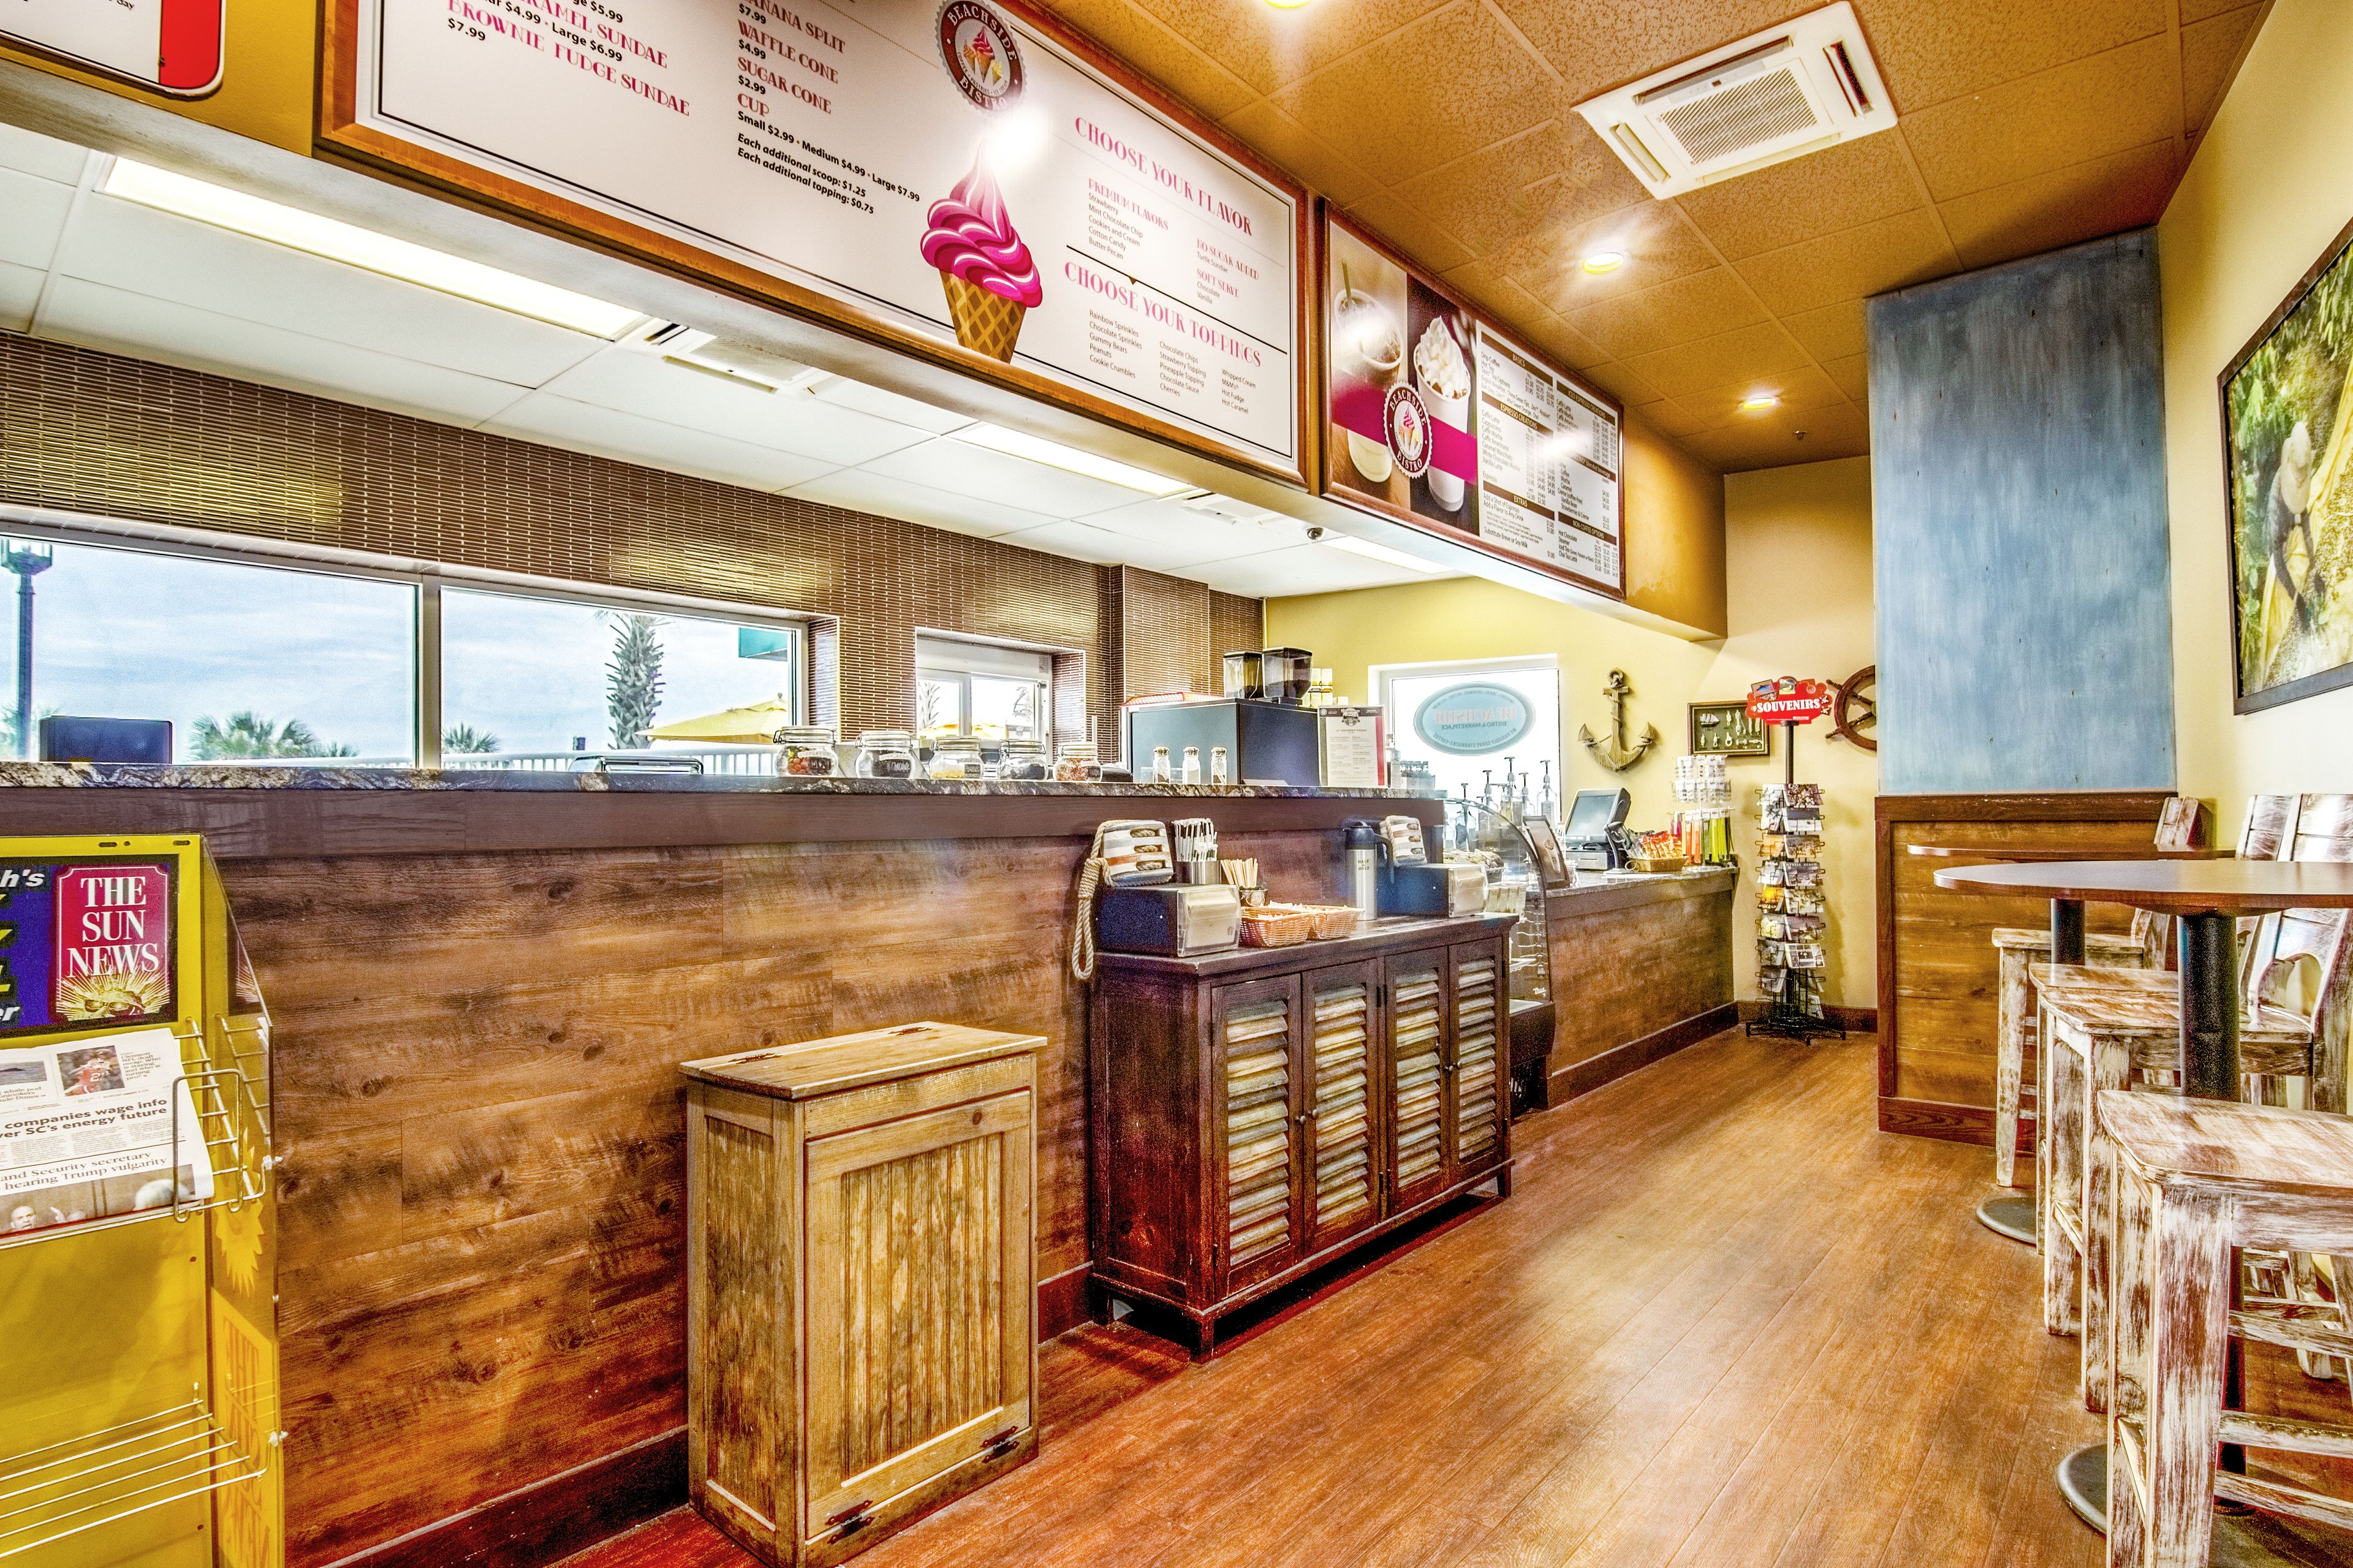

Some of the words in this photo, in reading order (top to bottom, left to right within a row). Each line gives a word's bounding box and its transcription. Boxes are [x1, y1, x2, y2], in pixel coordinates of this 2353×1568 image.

[591, 1, 623, 23] $5.99
[739, 4, 766, 24] $7.99
[448, 18, 486, 41] $7.99
[506, 1, 541, 24] $4.99
[552, 22, 586, 47] Large
[591, 40, 623, 62] $6.99
[746, 0, 802, 31] ANANA
[806, 23, 846, 53] SPLIT
[948, 4, 1017, 60] BEACHSIDE
[597, 23, 667, 68] SUNDAE
[738, 19, 795, 62] WAFFLE
[799, 54, 838, 84] CONE
[739, 39, 766, 59] $4.99
[447, 0, 544, 51] BROWNIE
[554, 43, 616, 84] FUDGE
[621, 73, 689, 117] SUNDAE
[738, 75, 766, 94] $2.99
[738, 57, 789, 93] SUGAR
[792, 84, 831, 114] CONE
[960, 75, 1008, 110] BISTRO
[738, 93, 769, 116] CUP
[738, 111, 765, 131] Small
[768, 125, 794, 143] $2.99
[802, 140, 839, 165] Medium
[841, 159, 865, 176] $4.99
[873, 173, 896, 191] Large
[898, 186, 920, 202] $7.99
[738, 133, 760, 150] Each
[763, 146, 810, 173] additional
[813, 167, 840, 187] scoop:
[843, 181, 866, 197] $1.25
[738, 148, 760, 165] Each
[763, 161, 810, 186] additional
[813, 180, 849, 204] topping:
[851, 198, 874, 214] $0.75
[1075, 117, 1147, 174] CHOOSE
[1152, 161, 1194, 201] YOUR
[1199, 189, 1252, 236] FLAVOR
[1089, 178, 1130, 211] PREMIUM
[1132, 202, 1169, 230] FLAVORS
[1089, 193, 1118, 215] Strawberry
[1089, 204, 1101, 217] Mint
[1103, 209, 1129, 231] Chocolate
[1131, 224, 1143, 239] Chip
[1089, 215, 1110, 230] Cookies
[1112, 225, 1121, 236] and
[1123, 231, 1140, 247] Cream
[1089, 226, 1107, 240] Cotton
[1109, 236, 1126, 251] Candy
[1089, 237, 1106, 249] Butter
[1107, 246, 1123, 259] Pecan
[1197, 238, 1207, 252] NO
[1210, 244, 1233, 265] SUGAR
[1235, 259, 1259, 279] ADDED
[1197, 251, 1210, 264] Turtle
[1211, 257, 1227, 273] Sundae
[1197, 268, 1216, 289] SOFT
[1218, 279, 1240, 298] SERVE
[1197, 282, 1220, 298] Chocolate
[1197, 292, 1213, 304] Vanilla
[1065, 262, 1138, 312] CHOOSE
[1143, 297, 1186, 333] YOUR
[1190, 319, 1260, 368] TOPPINGS
[1089, 309, 1113, 327] Rainbow
[1115, 320, 1139, 338] Sprinkles
[1089, 321, 1116, 339] Chocolate
[1118, 333, 1142, 350] Sprinkles
[1089, 332, 1111, 349] Gummy
[1113, 341, 1127, 354] Bears
[1089, 343, 1112, 358] Peanuts
[1160, 341, 1183, 357] Chocolate
[1185, 350, 1198, 364] Chips
[1513, 354, 1525, 367] BASICS
[1089, 355, 1109, 369] Cookie
[1110, 362, 1135, 379] Crumbles
[1160, 352, 1186, 370] Strawberry
[1187, 362, 1206, 378] Topping
[1160, 362, 1183, 380] Pineapple
[1184, 371, 1204, 387] Topping
[1160, 373, 1184, 388] Chocolate
[1185, 382, 1199, 394] Sauce
[1160, 383, 1180, 397] Cherries
[1222, 369, 1241, 384] Whipped
[1242, 377, 1256, 388] Cream
[1222, 399, 1230, 407] Hot
[1232, 403, 1248, 414] Caramel
[1232, 392, 1244, 403] Fudge
[1390, 390, 1426, 425] BEACHSIDE
[1576, 395, 1590, 408] ESPRESSO
[1501, 403, 1517, 419] ESPRESSO
[1518, 412, 1537, 430] CREATIONS
[1396, 450, 1422, 471] BISTRO
[1514, 496, 1527, 507] EXTRAS
[1573, 521, 1591, 534] NON-COFFEE
[1592, 529, 1604, 539] OPTIONS
[1757, 699, 1821, 713] SOUVENIRS
[81, 877, 146, 907] THE
[83, 910, 146, 942] SUN
[67, 943, 159, 978] NEWS
[5, 1111, 91, 1129] companies
[96, 1104, 134, 1118] wage
[138, 1099, 167, 1108] info
[26, 1125, 58, 1135] SC's
[63, 1116, 115, 1131] energy
[120, 1108, 167, 1120] future
[6, 1175, 58, 1189] hearing
[62, 1167, 107, 1180] Trump
[112, 1157, 167, 1172] vulgarity
[31, 1162, 88, 1176] Security
[92, 1152, 151, 1167] secretary
